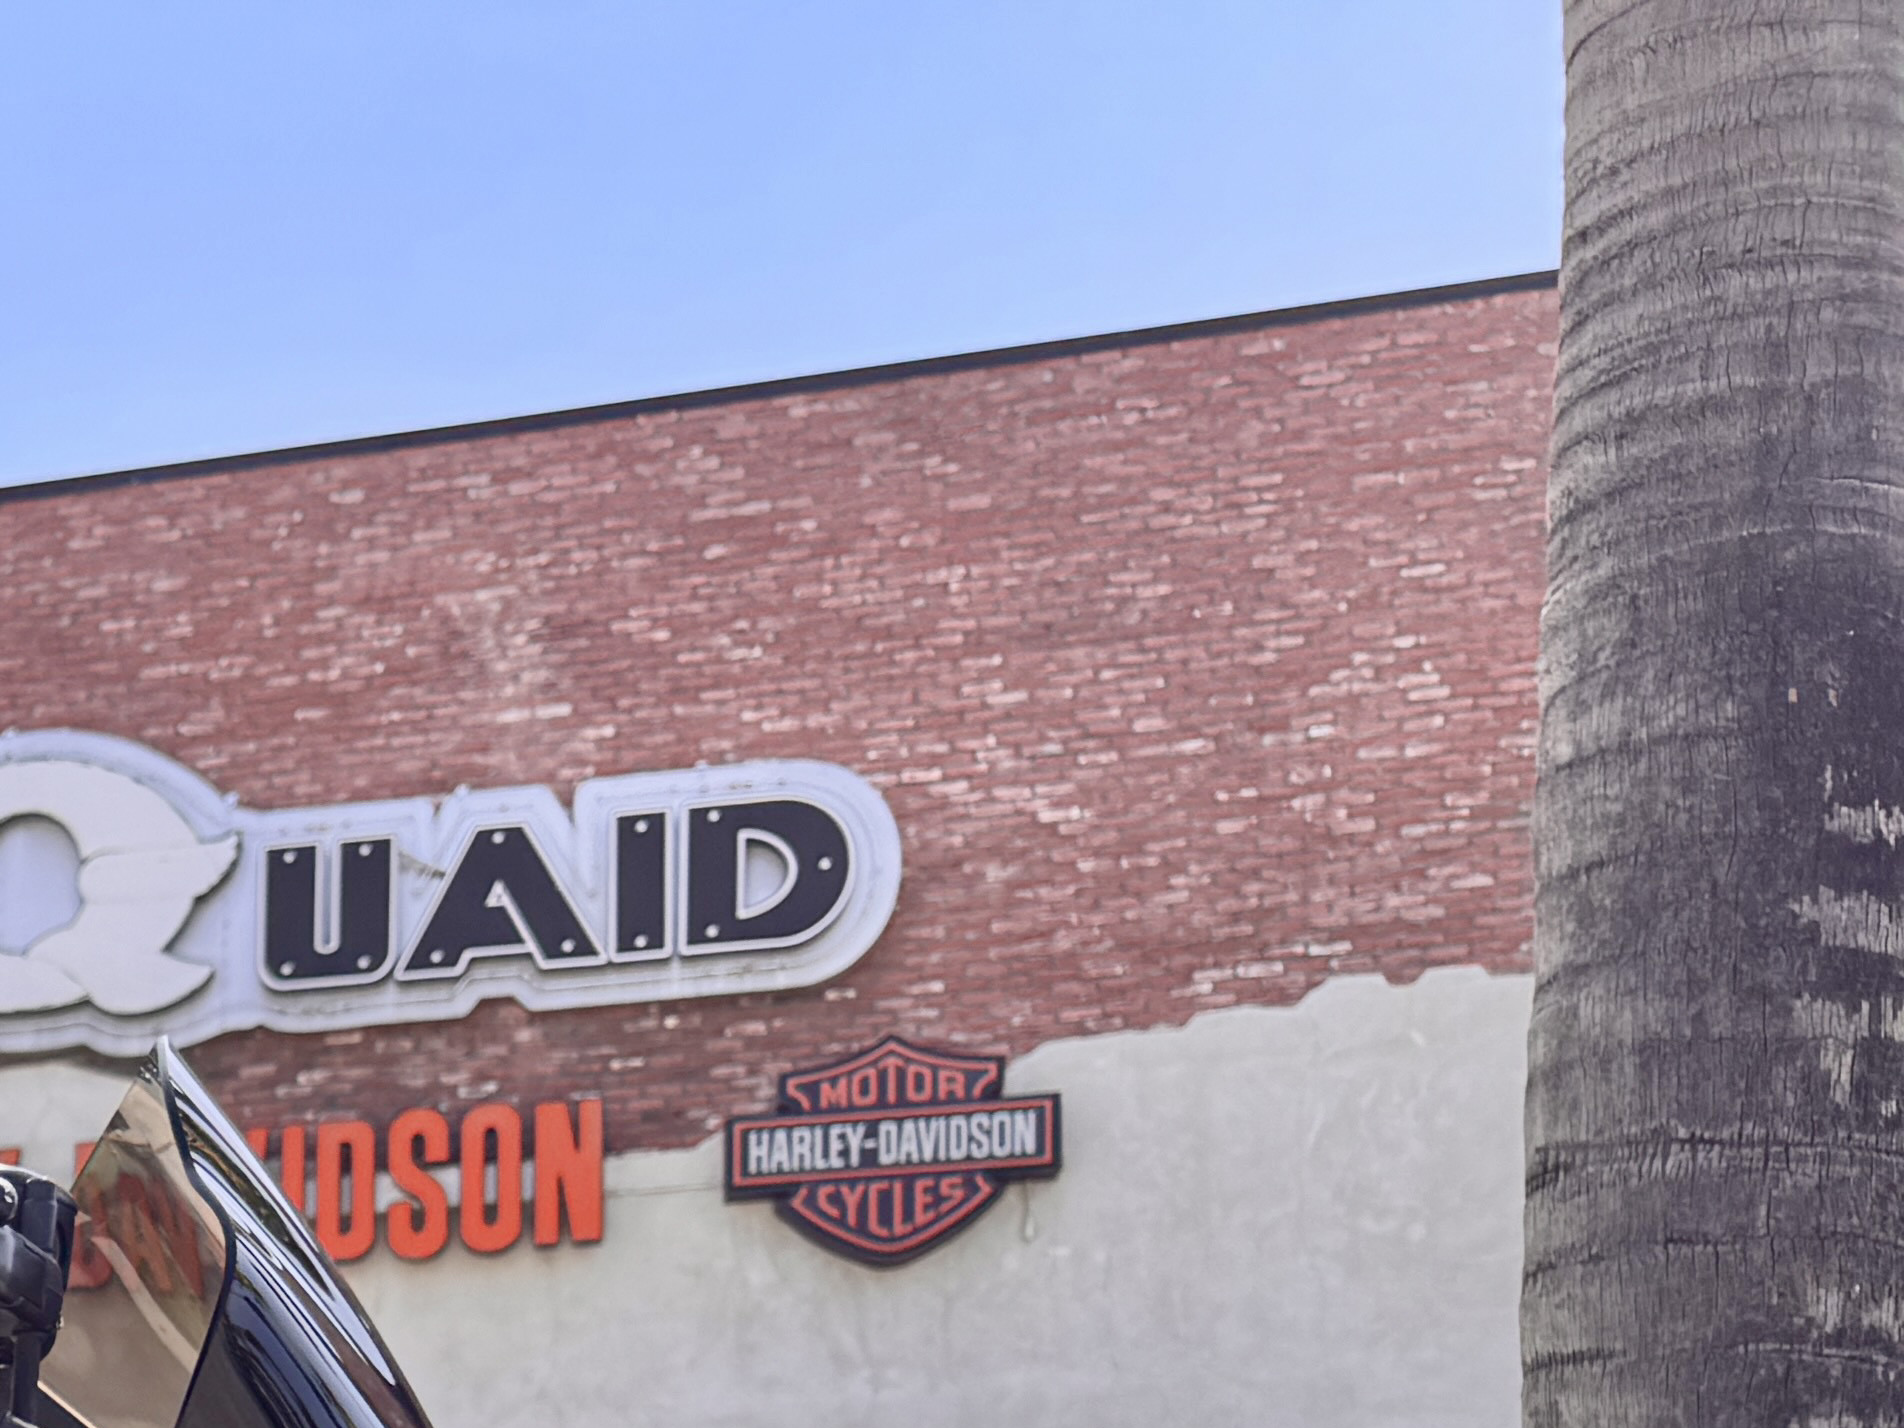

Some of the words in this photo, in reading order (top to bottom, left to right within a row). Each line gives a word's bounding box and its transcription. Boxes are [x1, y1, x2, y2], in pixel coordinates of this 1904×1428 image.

[819, 1056, 967, 1110] MOTOR
[747, 1109, 1038, 1175] HARLEY-DAVIDSON
[816, 1175, 967, 1239] CYCLES
